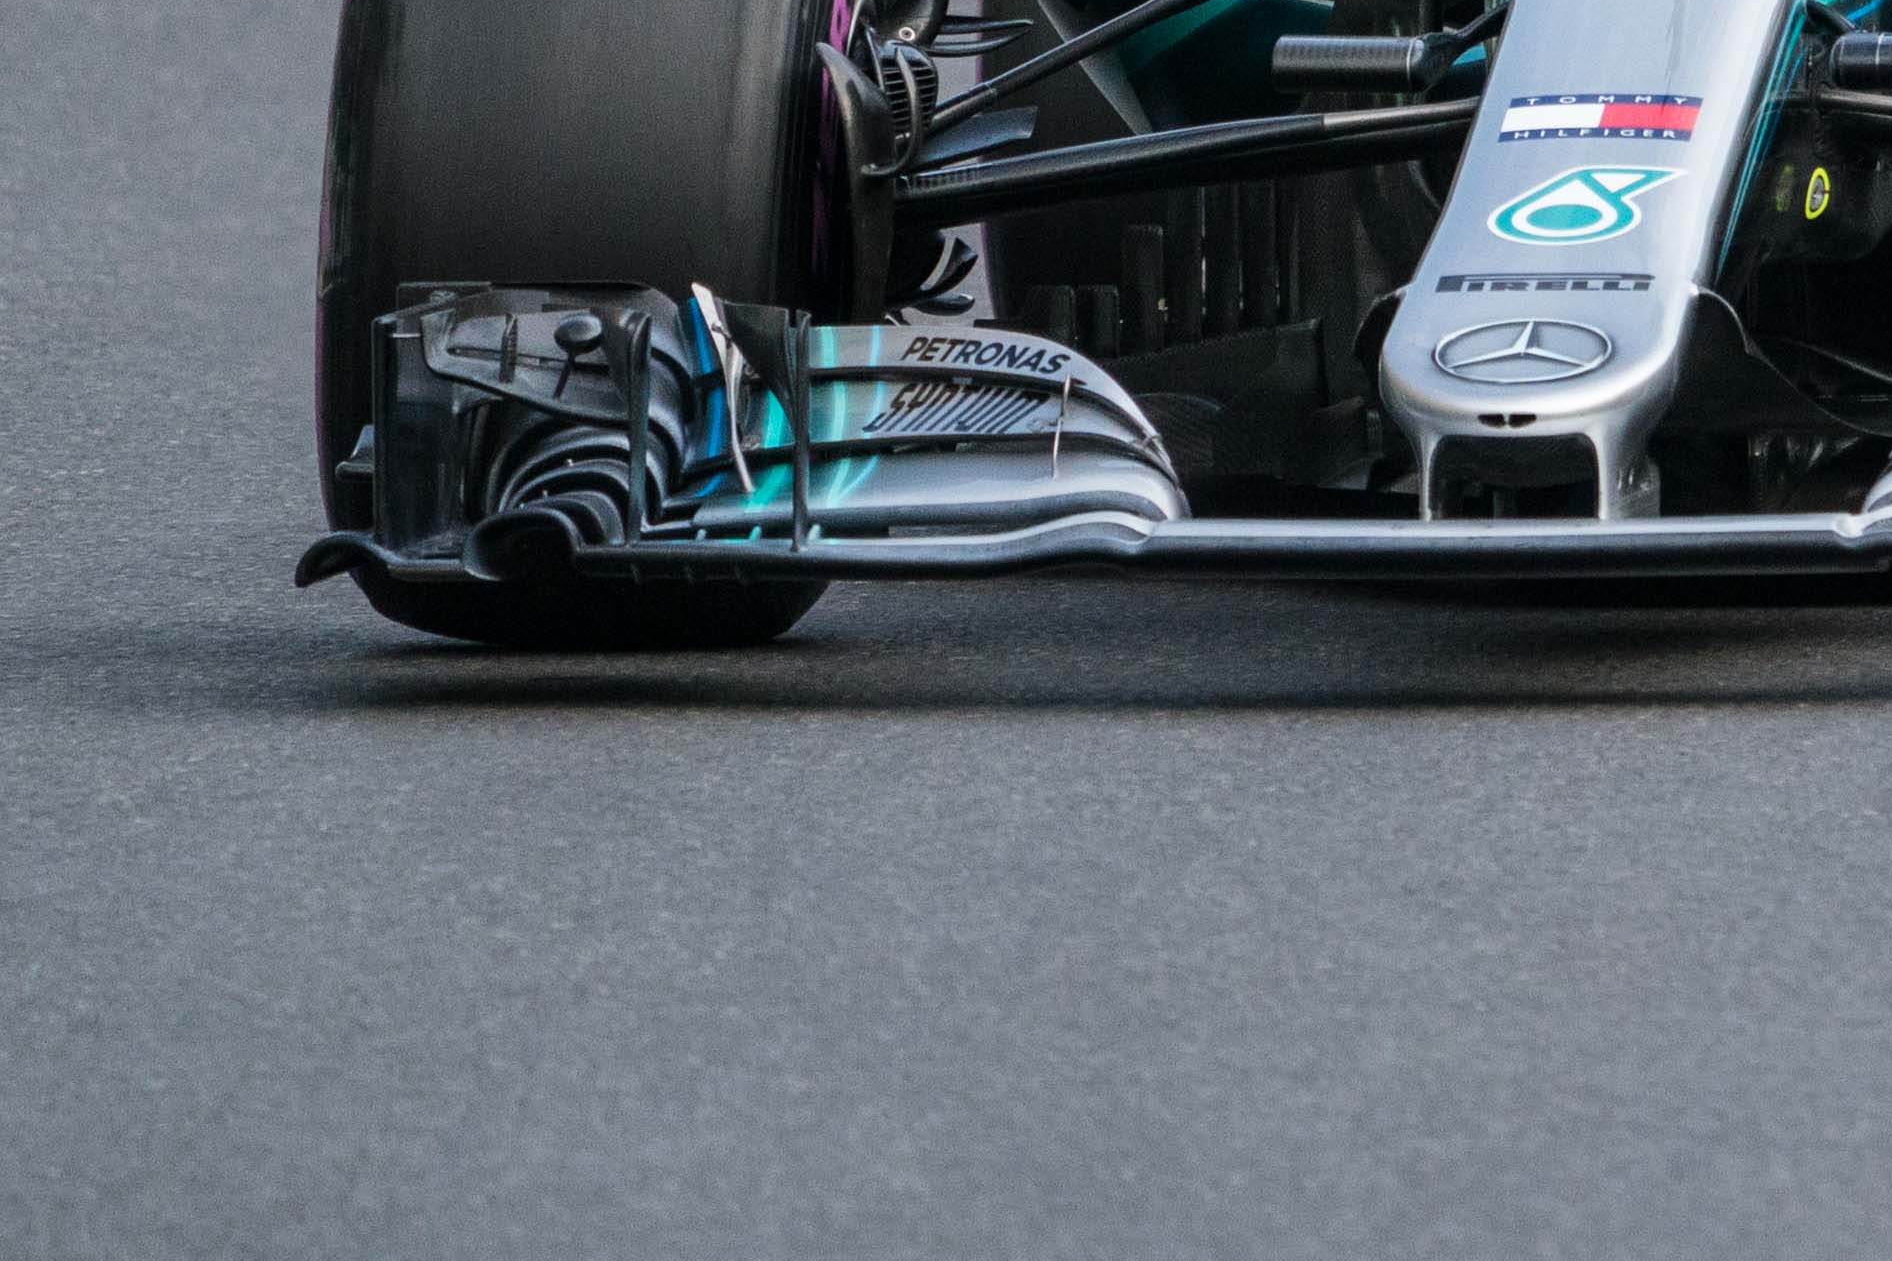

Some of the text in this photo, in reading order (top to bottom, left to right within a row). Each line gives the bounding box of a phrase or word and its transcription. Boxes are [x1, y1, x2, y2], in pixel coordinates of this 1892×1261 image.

[1527, 96, 1688, 106] TOMMY
[1514, 129, 1676, 139] HILFIGER
[1435, 272, 1656, 293] PIRELLI
[902, 337, 1070, 374] PETRONAS
